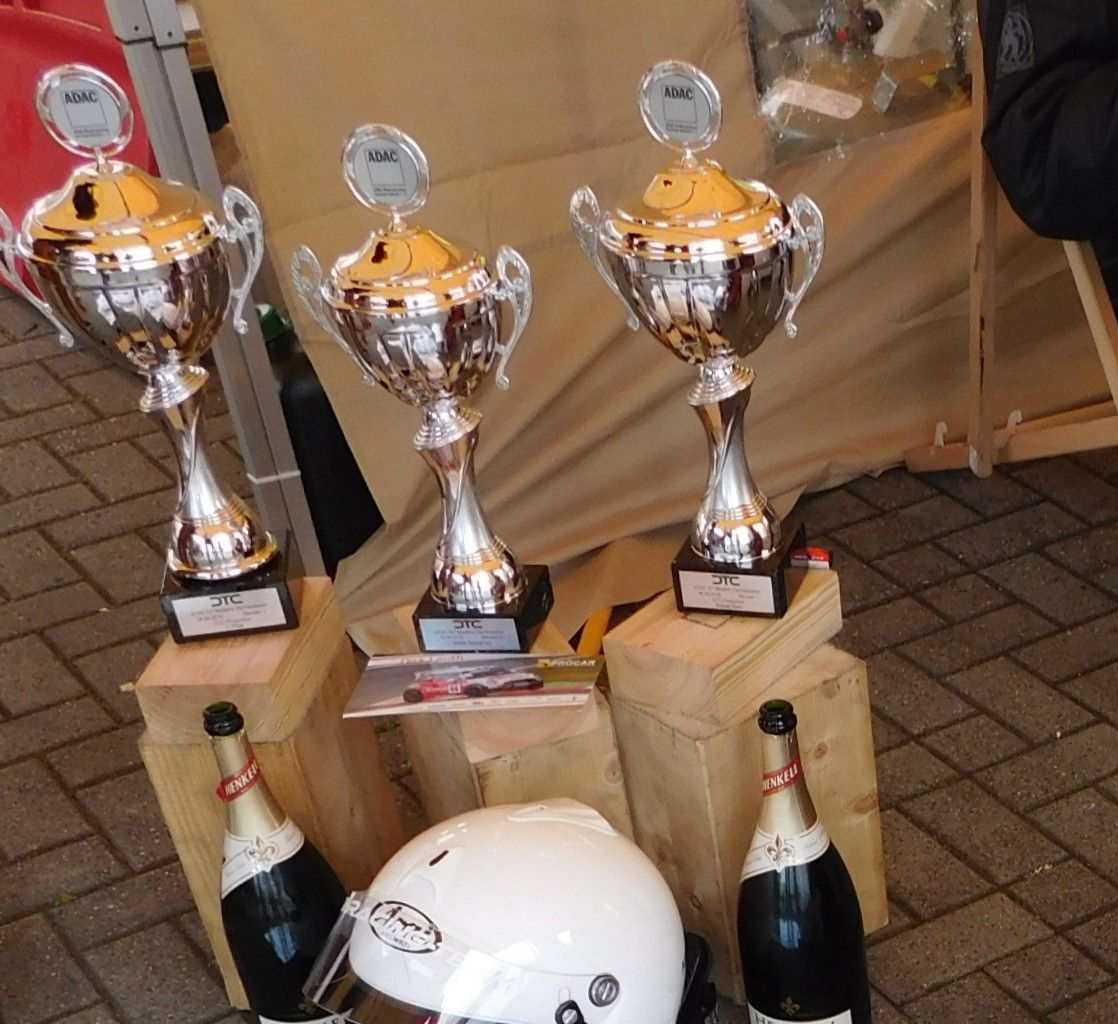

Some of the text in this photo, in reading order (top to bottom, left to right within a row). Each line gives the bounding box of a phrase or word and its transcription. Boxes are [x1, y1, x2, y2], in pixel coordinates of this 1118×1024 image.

[65, 91, 98, 104] ADAC
[664, 87, 693, 101] ADAC
[368, 151, 398, 163] ADAC
